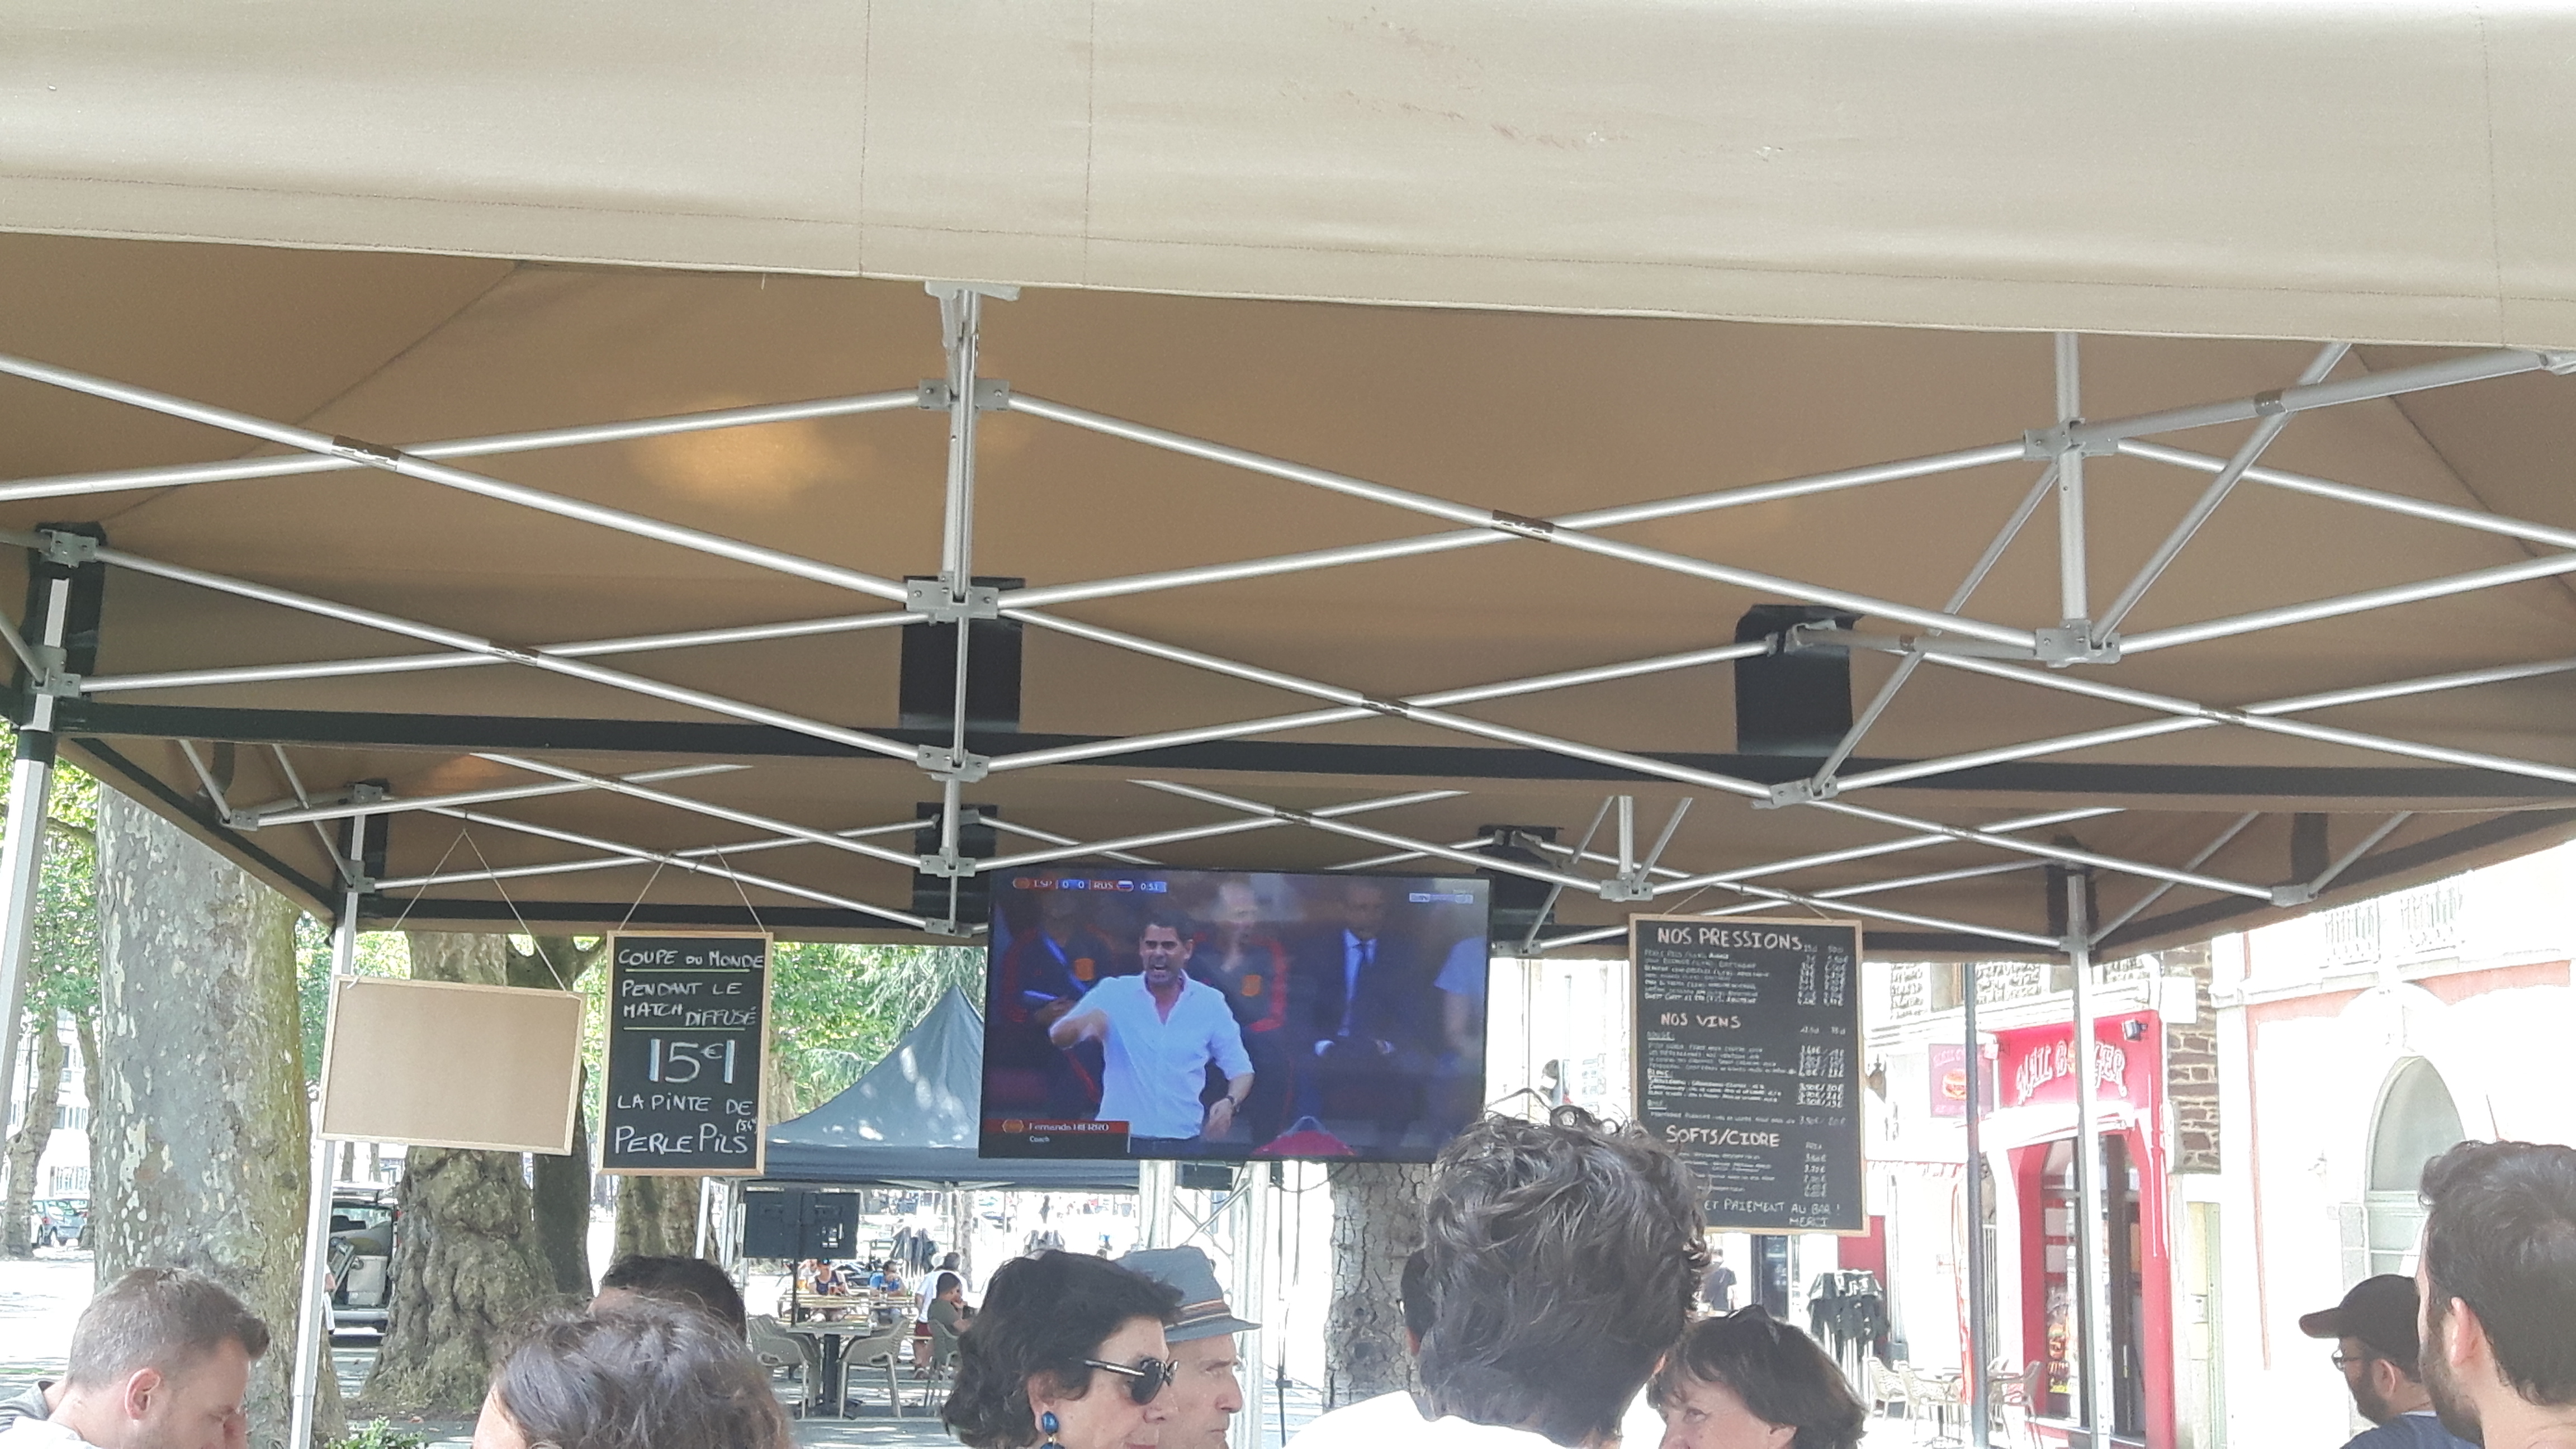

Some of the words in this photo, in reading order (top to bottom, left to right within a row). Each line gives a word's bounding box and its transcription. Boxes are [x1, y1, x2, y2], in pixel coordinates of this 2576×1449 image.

[1062, 880, 1069, 889] 0
[1078, 880, 1085, 889] 0
[1657, 927, 1692, 945] NOS
[1699, 927, 1803, 951] PRESSIONS
[618, 949, 679, 966] COUPE
[708, 950, 765, 969] MONDE
[622, 979, 703, 998] PENDANT
[712, 982, 742, 995] LE
[623, 1002, 684, 1017] MATCH
[1661, 1012, 1688, 1027] NOS
[1696, 1015, 1742, 1029] VINS
[617, 1094, 644, 1110] LA
[726, 1099, 754, 1115] DE
[614, 1125, 694, 1155] PERLE
[1665, 1124, 1781, 1148] SOFTS/CIDRE
[1704, 1200, 1719, 1210] ET
[1724, 1197, 1785, 1213] PAIEMENT
[1791, 1204, 1806, 1214] AU
[1811, 1204, 1832, 1215] BAR
[1789, 1216, 1829, 1227] MERCI
